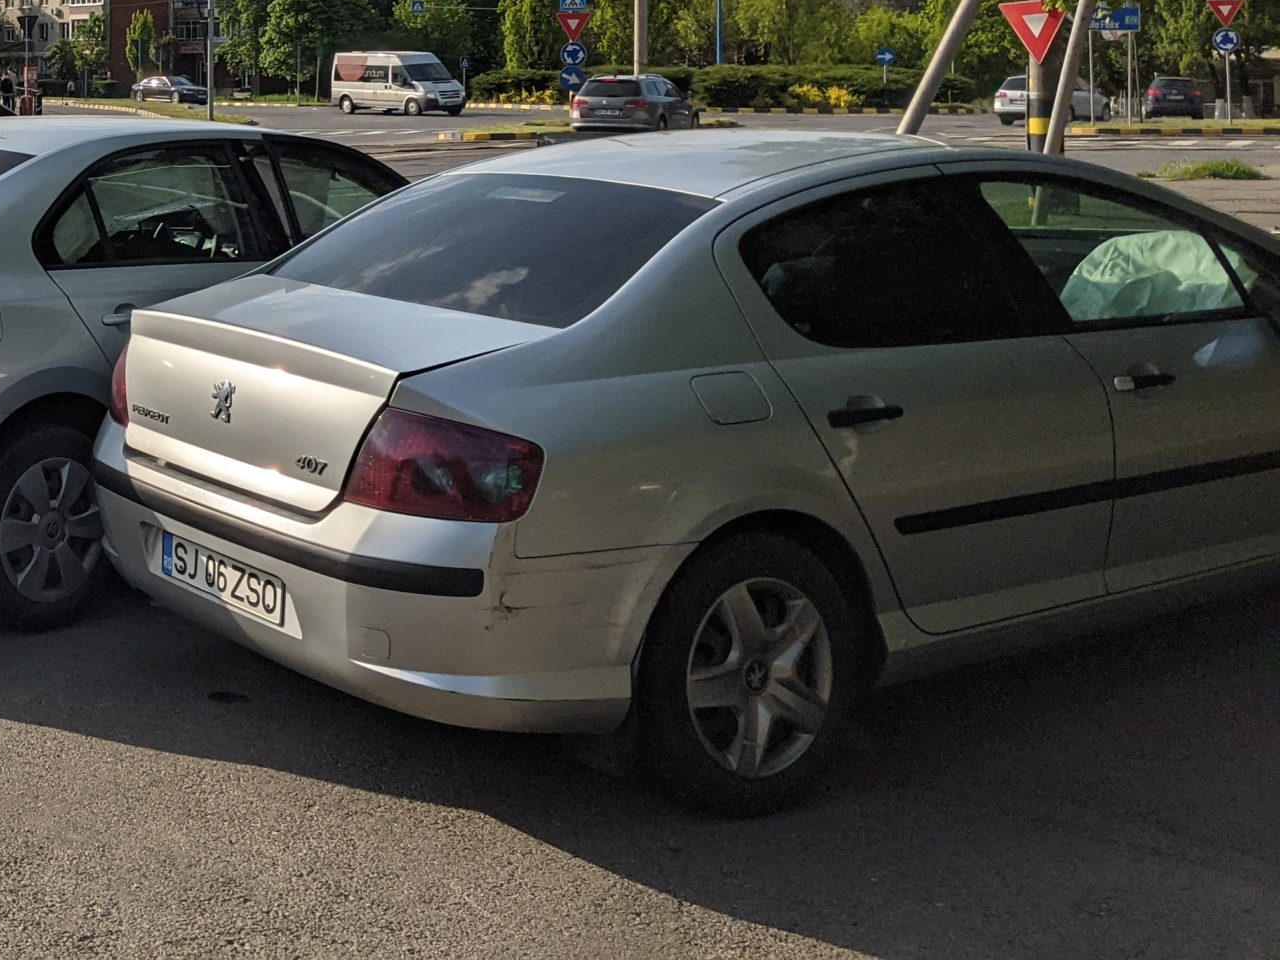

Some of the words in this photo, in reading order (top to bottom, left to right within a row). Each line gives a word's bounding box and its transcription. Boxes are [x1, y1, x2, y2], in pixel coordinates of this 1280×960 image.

[132, 402, 170, 425] PEUGEOT
[295, 454, 329, 476] 407
[174, 541, 199, 580] SJ
[205, 554, 228, 594] 06
[230, 563, 278, 614] ZSO
